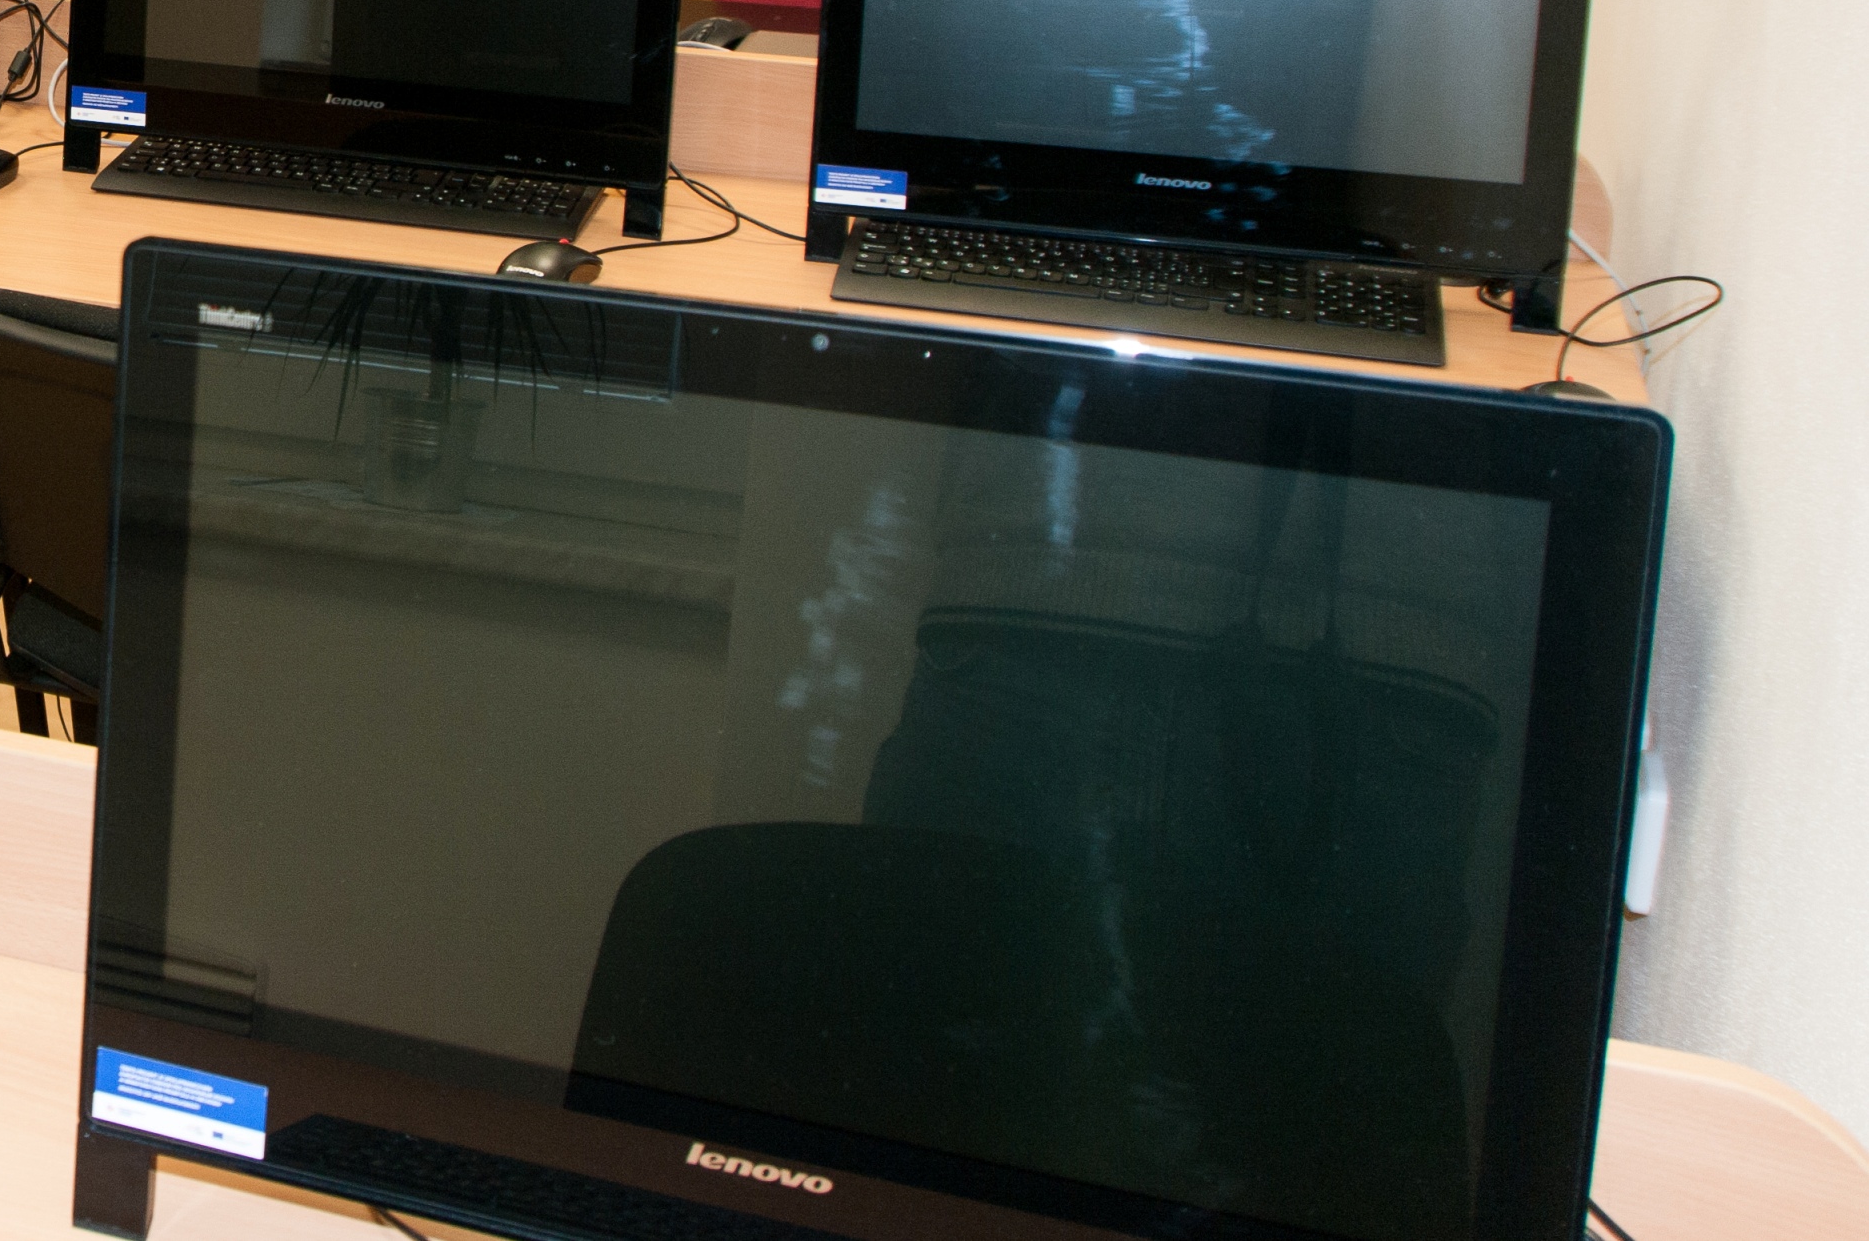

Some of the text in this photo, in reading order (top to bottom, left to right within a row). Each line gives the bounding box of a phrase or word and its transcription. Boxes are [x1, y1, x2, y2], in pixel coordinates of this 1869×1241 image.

[325, 93, 385, 109] lenovo
[1135, 173, 1212, 190] lenovo
[686, 1142, 834, 1194] lenovo
